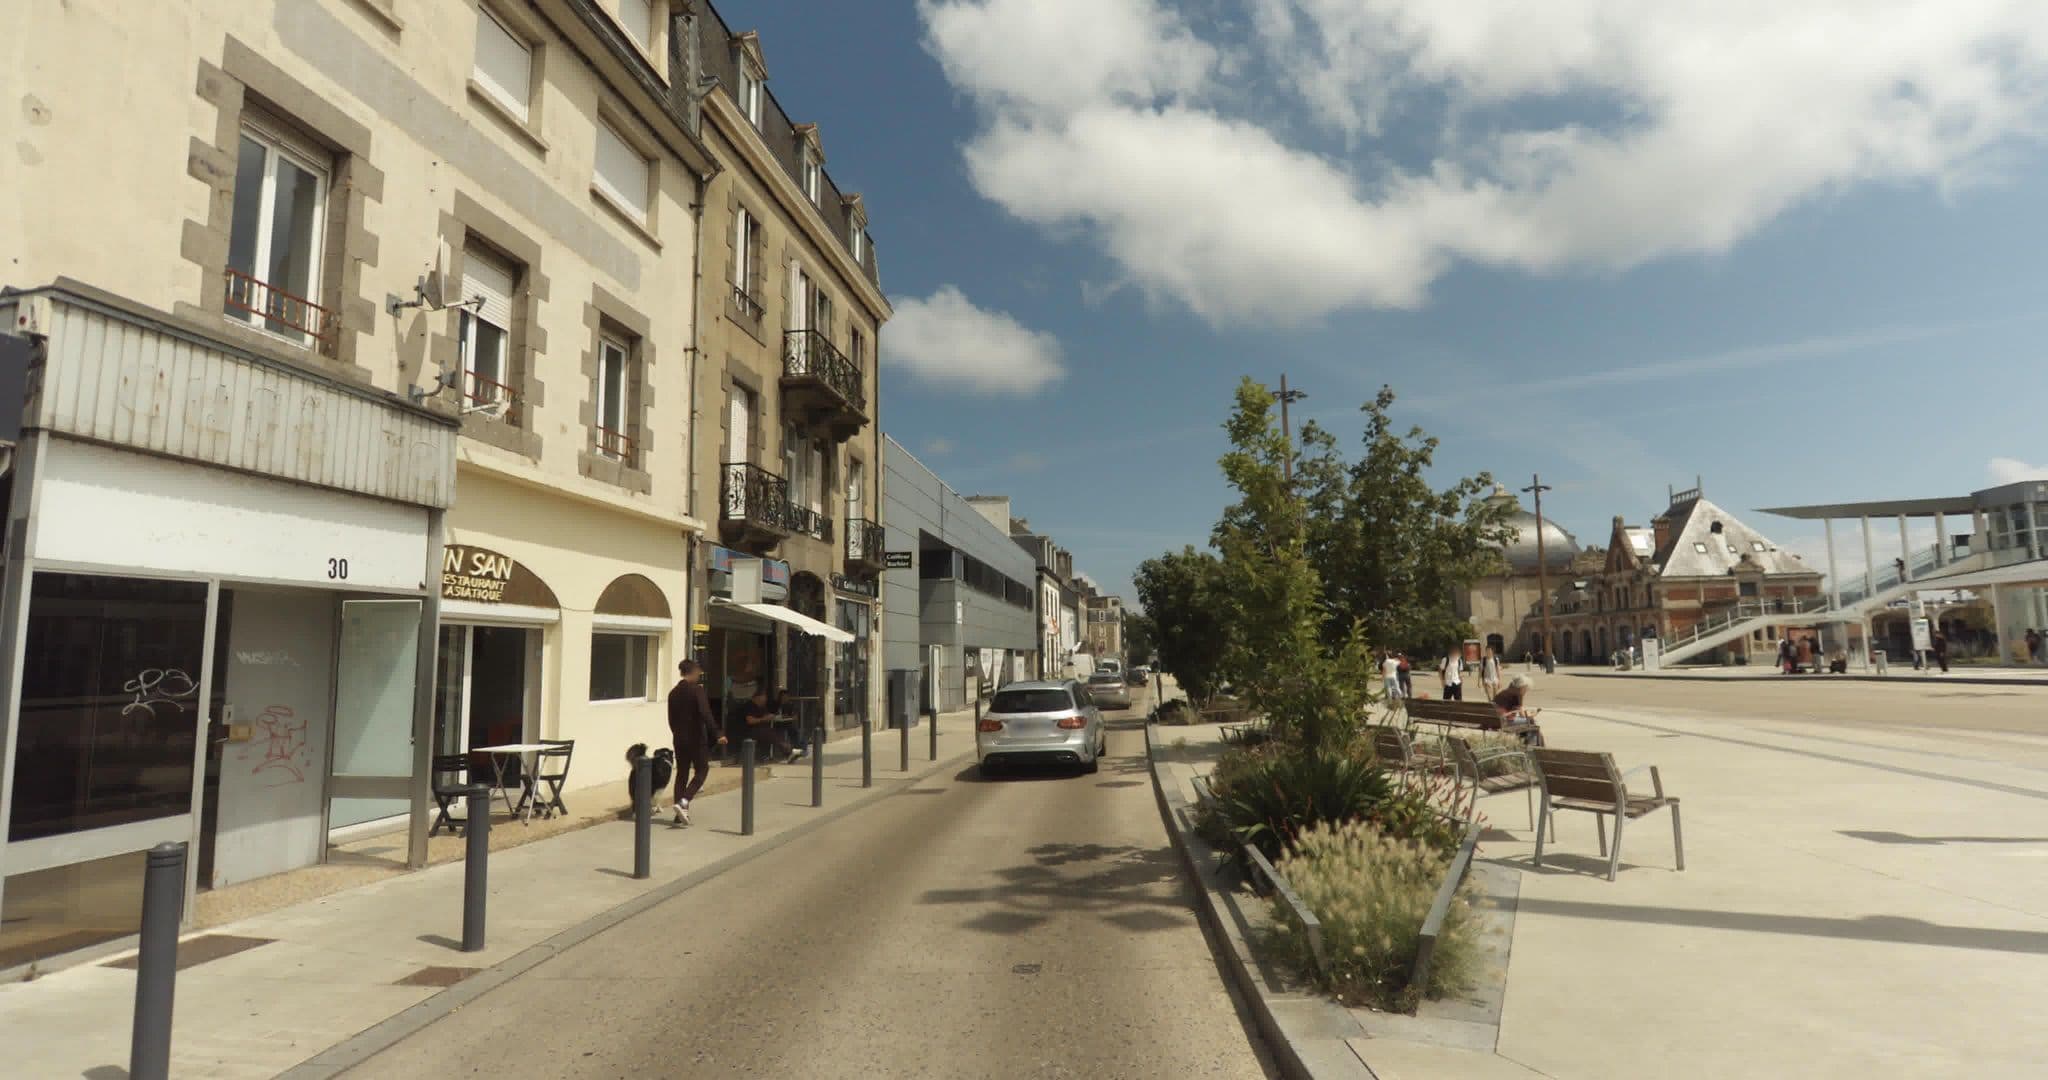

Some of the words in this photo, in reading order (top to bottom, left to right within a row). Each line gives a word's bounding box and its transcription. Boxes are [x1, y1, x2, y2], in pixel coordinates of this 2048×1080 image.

[328, 557, 348, 580] 30
[469, 552, 513, 580] SAN
[443, 573, 507, 591] ESTAURANT
[444, 585, 502, 601] ASIATIQUE
